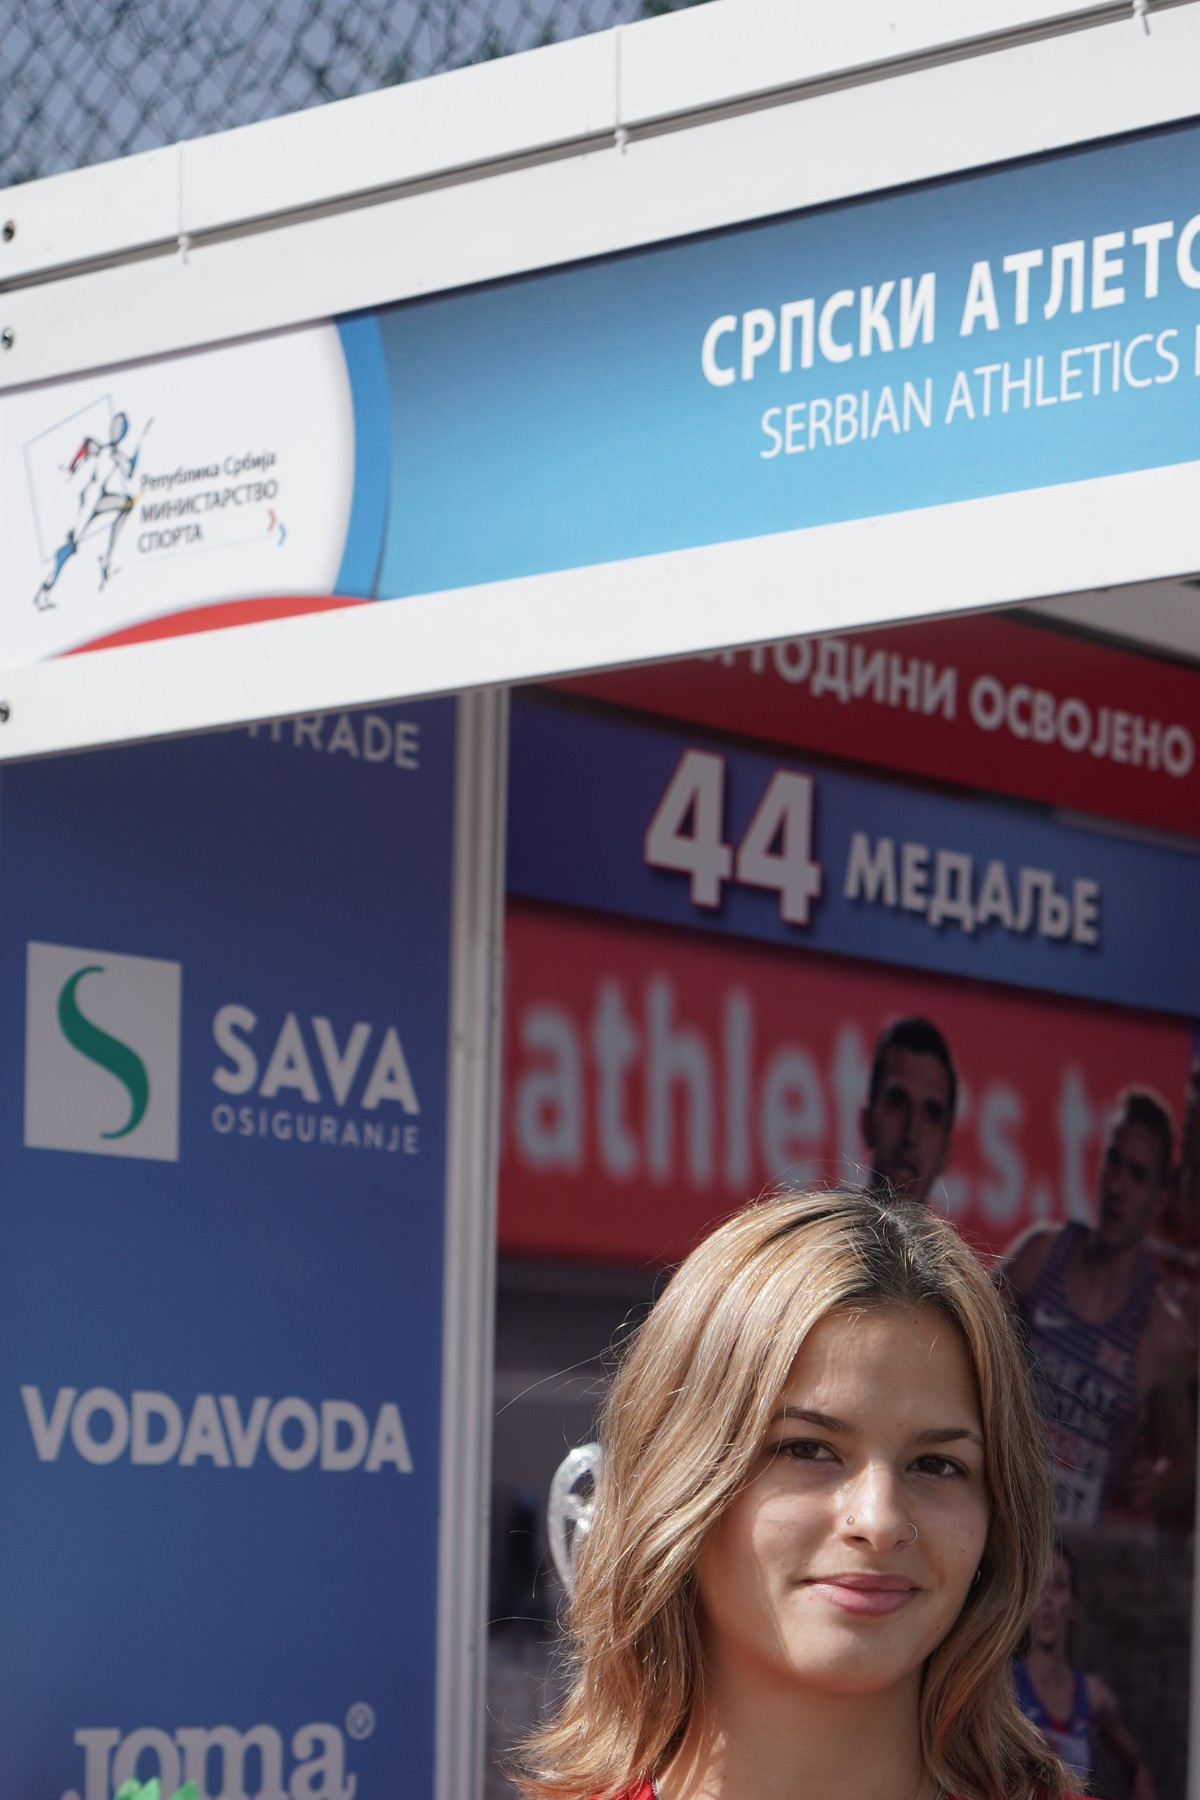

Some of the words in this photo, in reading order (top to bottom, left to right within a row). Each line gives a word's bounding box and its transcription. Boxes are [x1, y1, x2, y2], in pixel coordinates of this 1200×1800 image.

[701, 273, 936, 387] СРПСКИ
[760, 379, 933, 460] SERBIAN
[945, 333, 1179, 424] ATHLETICS
[140, 464, 219, 491] Република
[224, 450, 276, 478] Србија
[140, 479, 279, 524] МИНИСТАРСТВО
[137, 523, 203, 553] СПОРТА
[969, 675, 1196, 778] ОСВОЈЕНО
[643, 745, 821, 927] 44
[844, 831, 1101, 947] МЕДАЉЕ
[211, 1003, 421, 1116] SAVA
[211, 1104, 419, 1155] OSIGURANJE
[20, 1385, 414, 1473] VODAVODA
